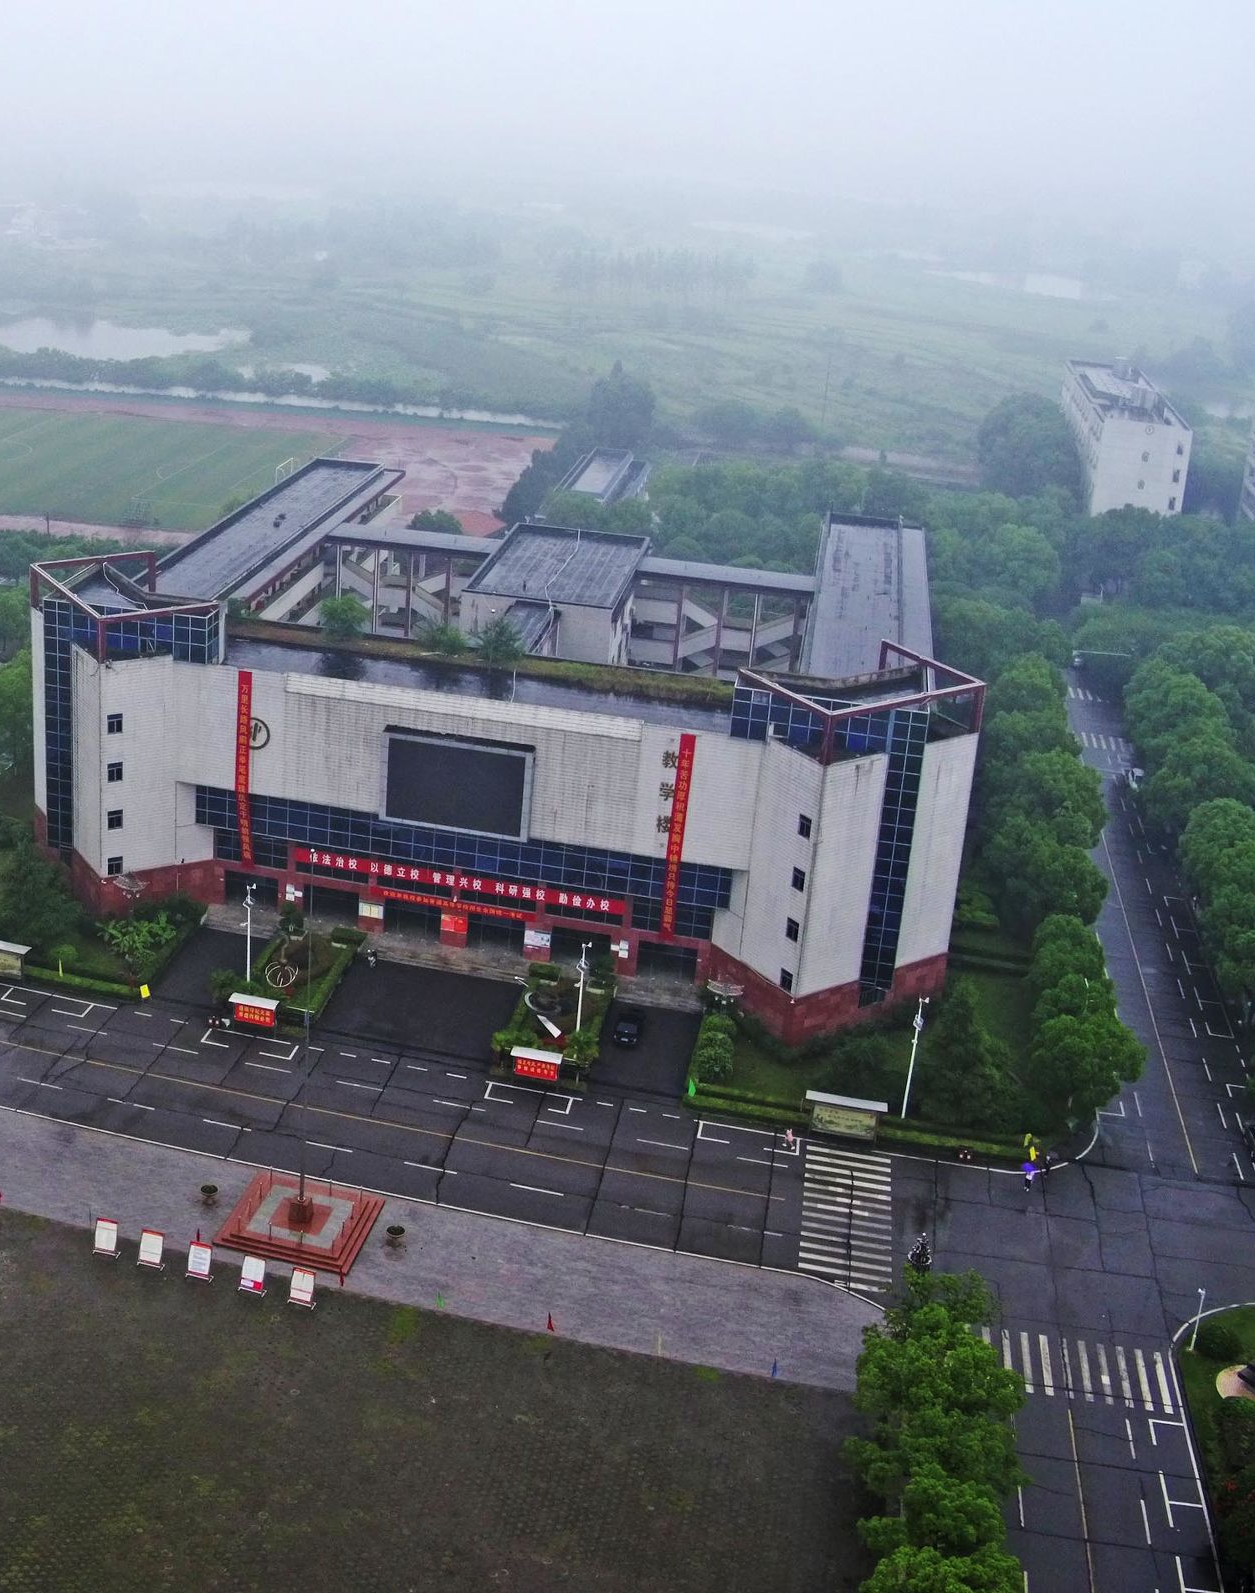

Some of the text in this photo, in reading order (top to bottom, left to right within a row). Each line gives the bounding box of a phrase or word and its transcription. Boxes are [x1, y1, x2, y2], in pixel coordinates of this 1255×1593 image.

[656, 750, 678, 833] 教学楼
[309, 852, 610, 912] 依法治校 以德立校 管理兴校 科研强校 勤俭办校
